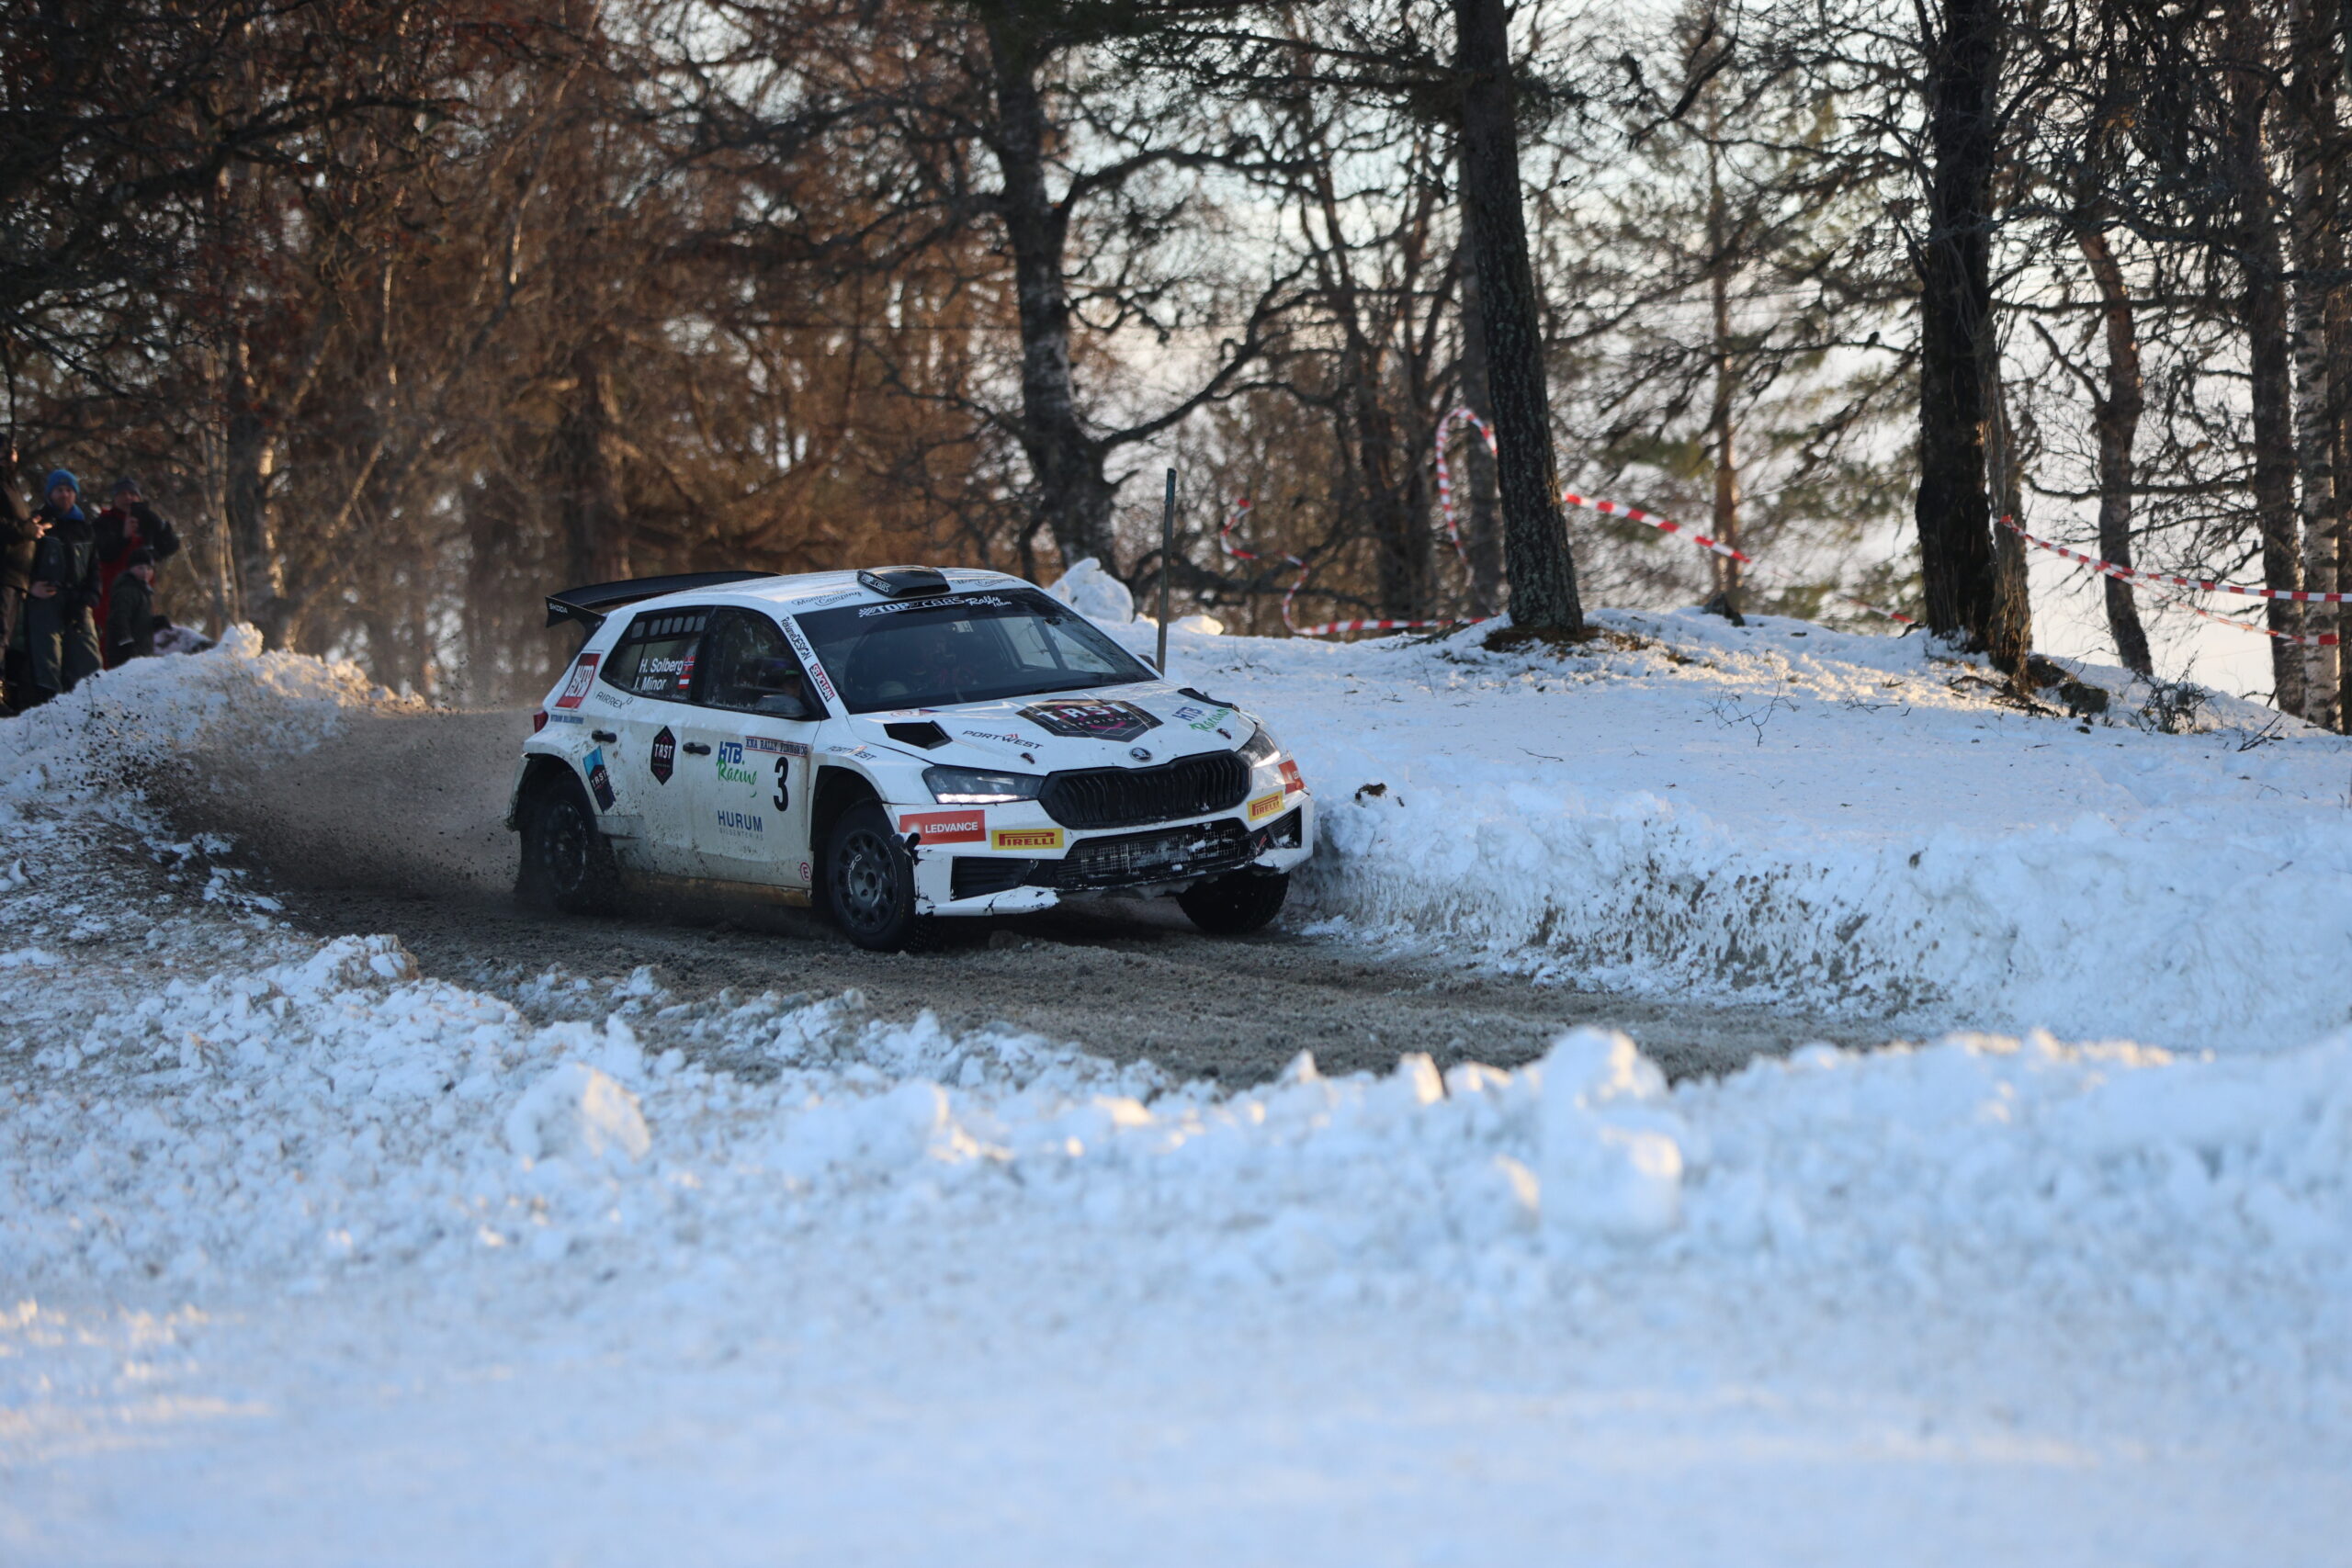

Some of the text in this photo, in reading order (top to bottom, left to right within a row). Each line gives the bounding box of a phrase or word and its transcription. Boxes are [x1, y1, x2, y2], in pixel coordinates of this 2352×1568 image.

[966, 595, 1001, 607] Rally
[639, 658, 684, 675] H. Solberg
[641, 676, 667, 691] Minor
[595, 691, 623, 709] AIRREX
[1189, 708, 1229, 732] Racing
[745, 738, 758, 748] KNA
[760, 739, 778, 751] RALLY
[963, 730, 1044, 750] PORTWEST
[716, 757, 757, 798] Racing
[773, 756, 789, 812] 3
[1252, 795, 1280, 817] PIRELLI
[718, 810, 763, 832] HURUM
[925, 821, 978, 834] LEDVANCE
[999, 832, 1055, 846] PIRELLI
